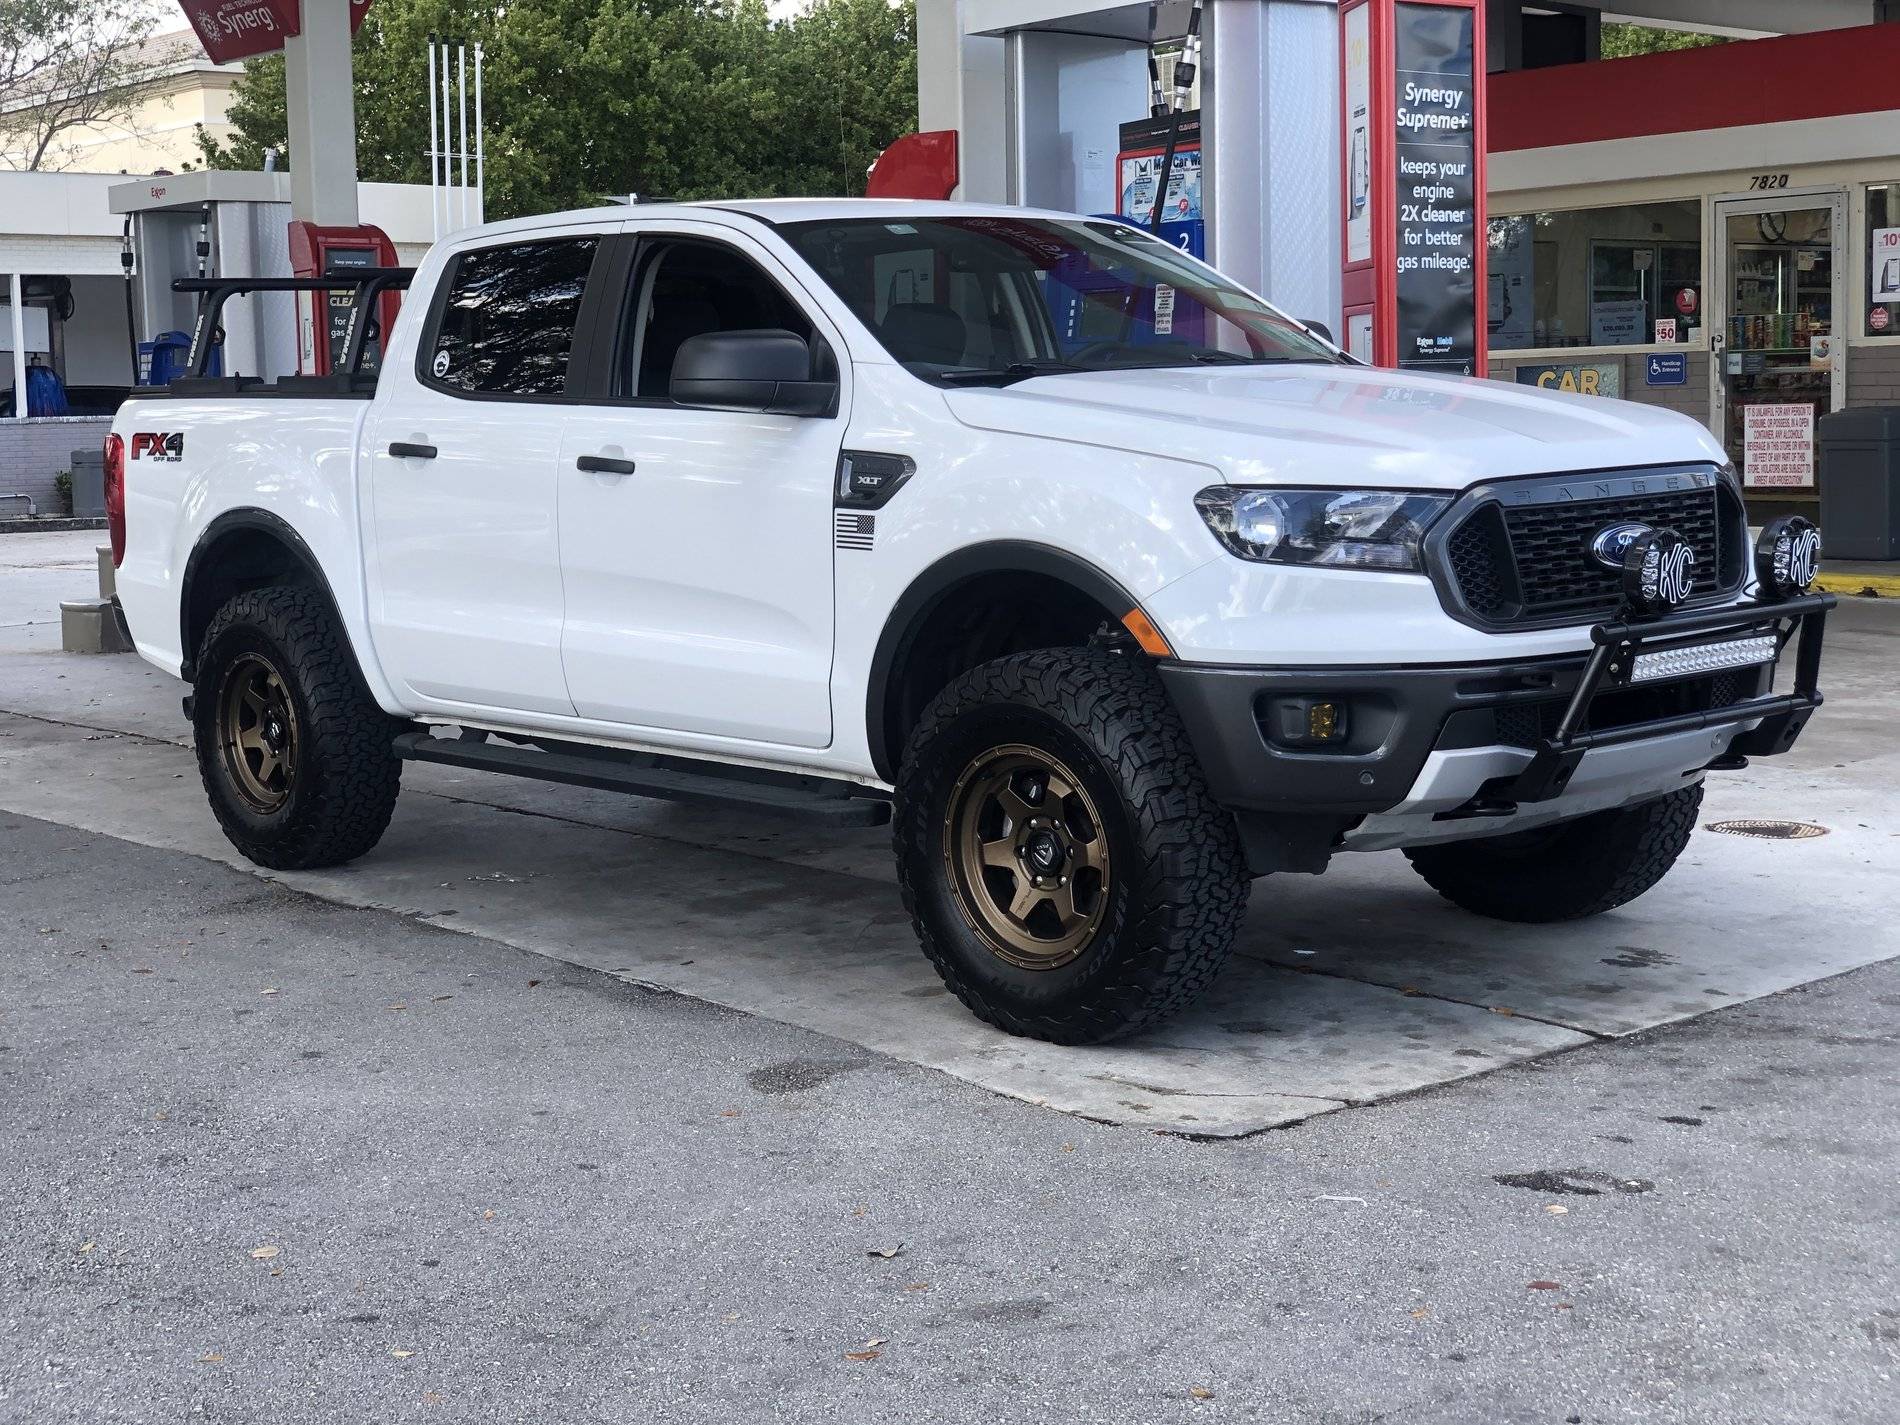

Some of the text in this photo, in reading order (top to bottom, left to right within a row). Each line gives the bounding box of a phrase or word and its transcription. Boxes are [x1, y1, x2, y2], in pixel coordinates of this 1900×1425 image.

[1405, 82, 1463, 109] Synergy
[1173, 156, 1188, 168] Car
[1400, 157, 1466, 179] keeps your
[1750, 174, 1789, 190] 7820
[151, 187, 167, 199] Exxon
[1413, 182, 1454, 202] engine
[1401, 205, 1465, 222] 2X cleaner
[1179, 232, 1189, 252] 2
[1404, 228, 1462, 245] for better
[1397, 255, 1418, 273] gas
[334, 317, 346, 325] for
[331, 329, 345, 339] gas
[1656, 328, 1674, 340] $50
[1416, 337, 1453, 347] Exxon Mobil
[1537, 369, 1600, 396] CAR
[1775, 407, 1783, 416] FOR
[1791, 407, 1806, 416] PERSON
[1799, 418, 1809, 428] OPEN
[1783, 430, 1804, 439] ALCOHOLIC
[131, 432, 184, 460] FX4
[1747, 441, 1766, 451] BEVERAGE
[1770, 441, 1779, 451] THIS
[1780, 441, 1791, 451] STORE
[1798, 441, 1810, 451] WITHIN
[1758, 453, 1767, 462] FEET
[1781, 453, 1791, 462] PART
[1797, 453, 1805, 462] THIS
[1761, 464, 1780, 473] VIOLATORS
[1780, 464, 1789, 473] ARE
[1789, 464, 1805, 473] SUBJECT
[857, 476, 882, 485] XLT
[1754, 475, 1768, 484] ARREST
[1768, 475, 1777, 484] AND
[1513, 473, 1711, 503] RANGER
[1791, 529, 1821, 587] KC
[1659, 543, 1694, 604] KC
